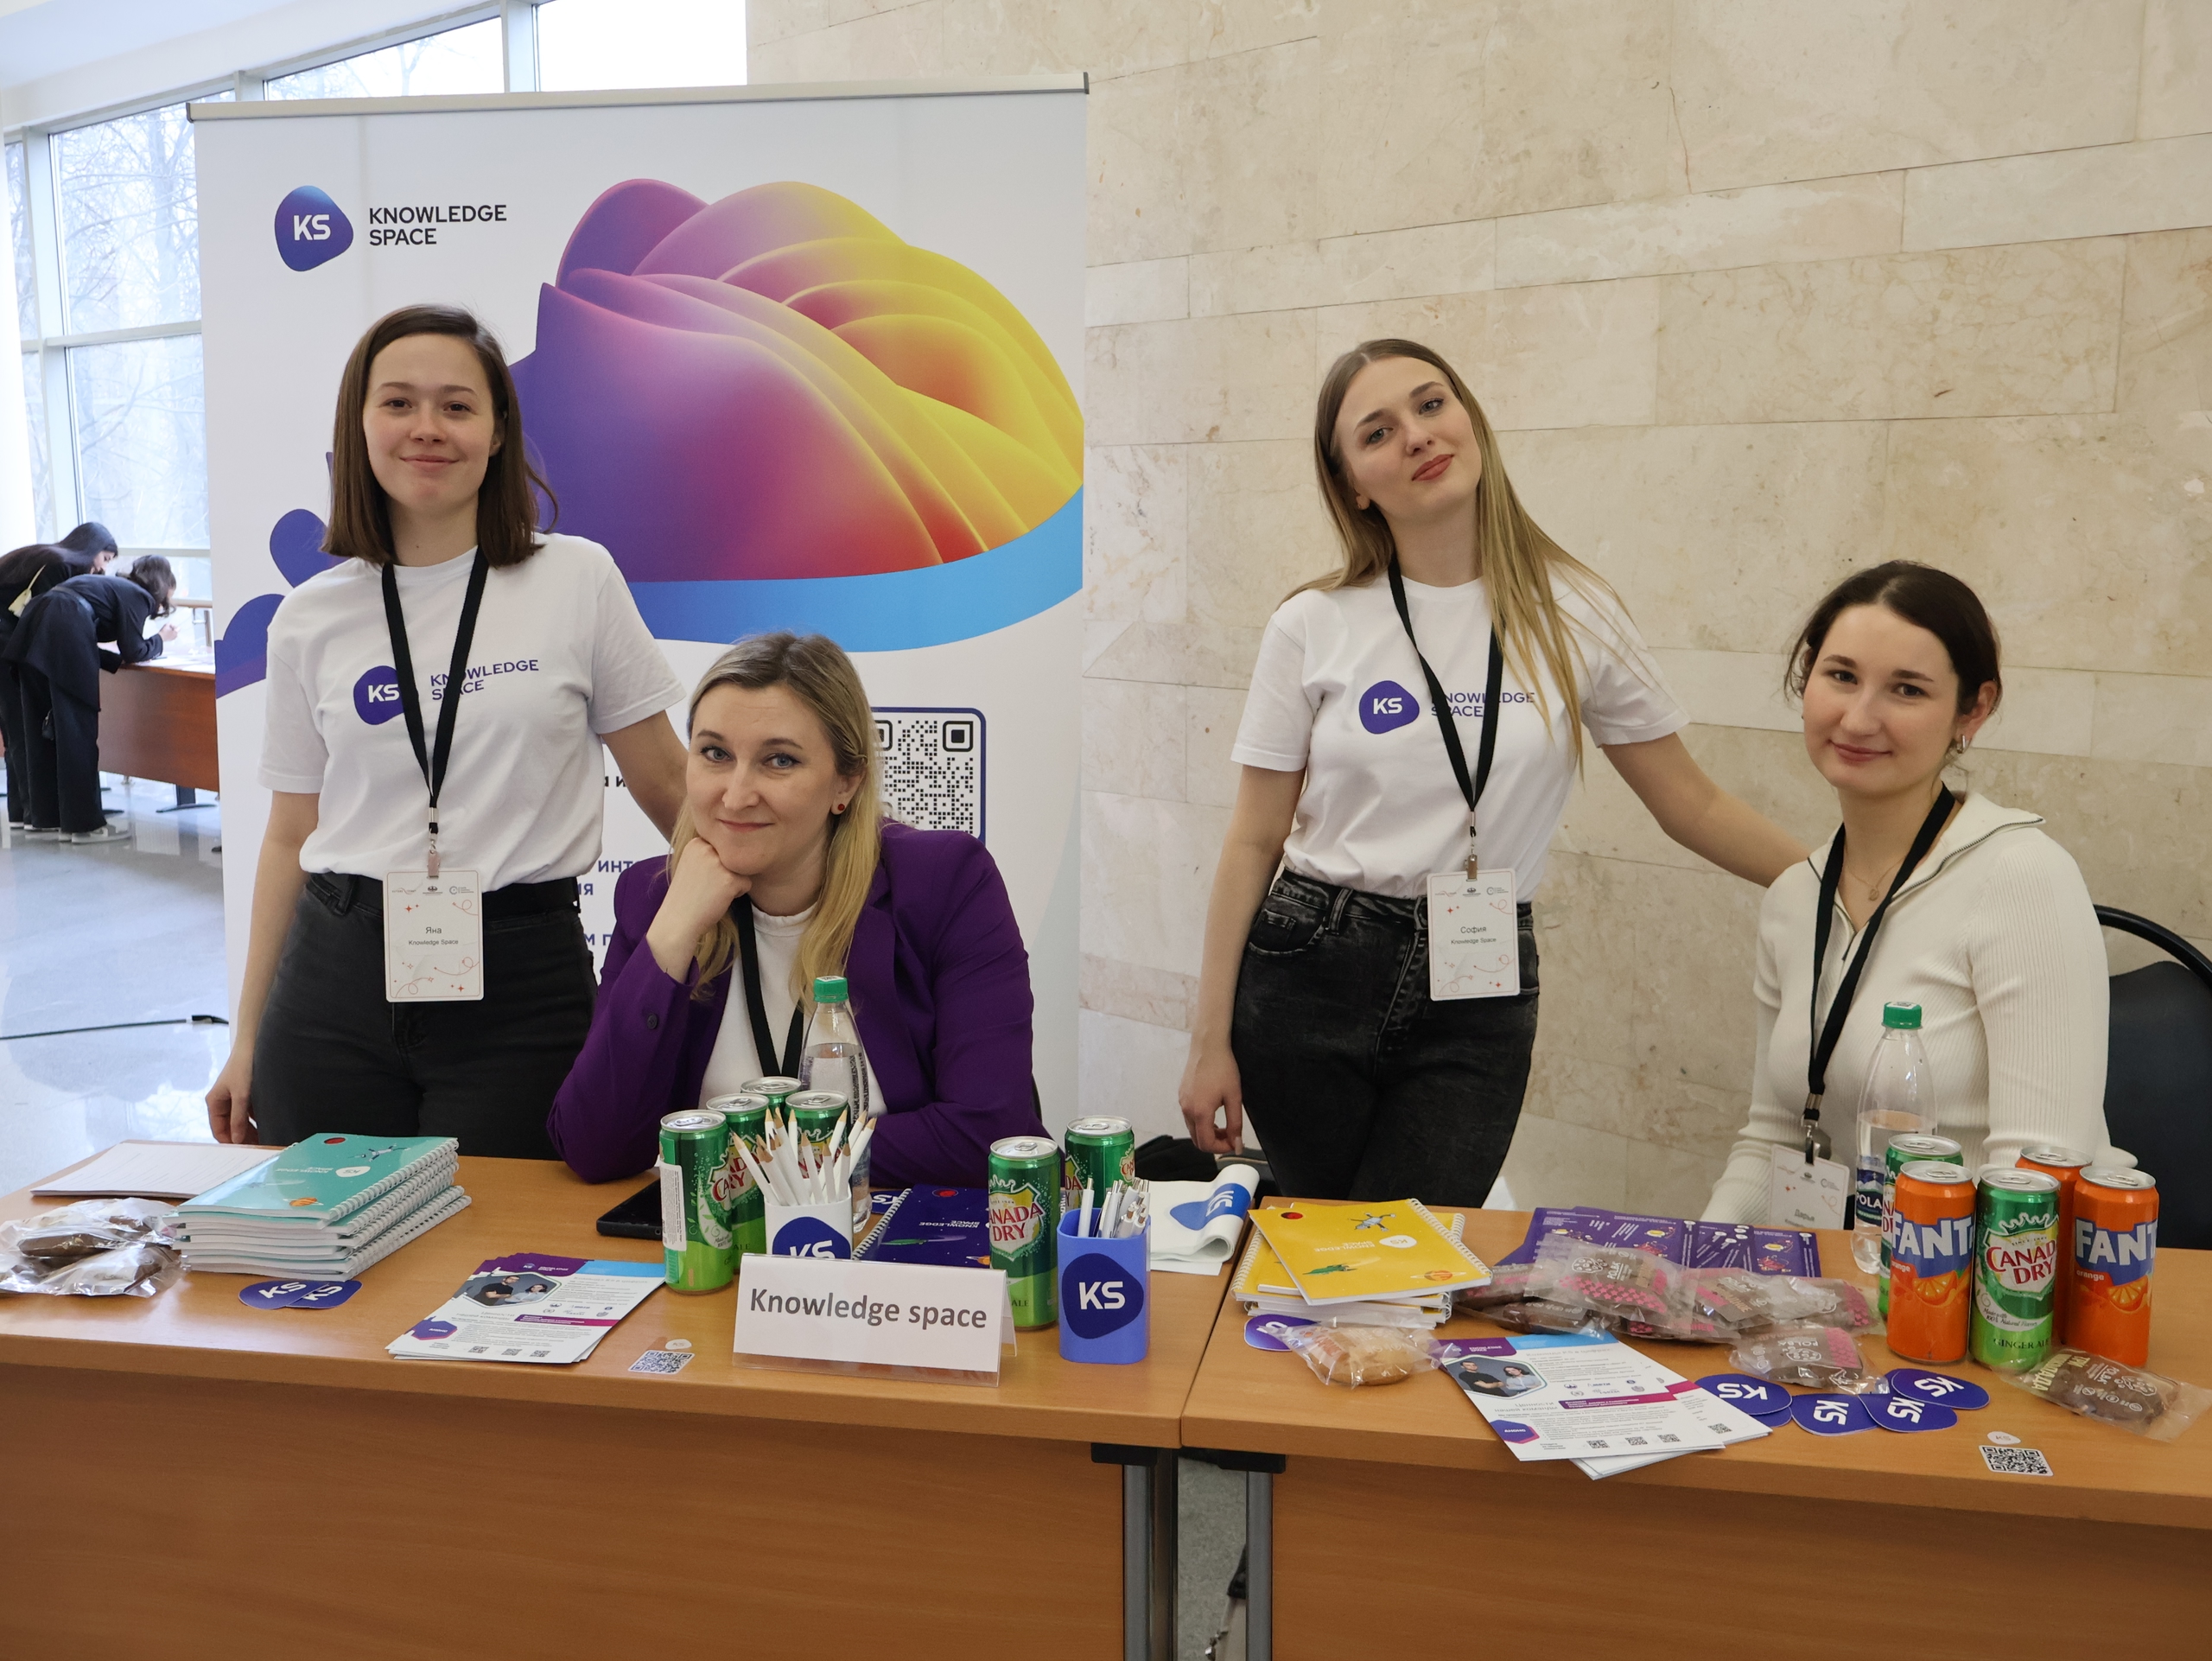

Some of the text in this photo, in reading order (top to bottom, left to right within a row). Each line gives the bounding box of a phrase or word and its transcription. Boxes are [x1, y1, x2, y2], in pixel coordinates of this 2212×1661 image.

[369, 205, 507, 225] KNOWLEDGE
[294, 214, 332, 241] KS
[369, 228, 437, 246] SPACE
[368, 684, 400, 703] KS
[432, 679, 485, 701] SCE
[1373, 697, 1403, 715] KS
[1431, 706, 1484, 717] SACE
[989, 1202, 1044, 1225] ANADA
[993, 1223, 1026, 1242] DRY
[2076, 1219, 2158, 1265] FANT
[1986, 1240, 2056, 1272] CANAD
[2013, 1258, 2053, 1285] DRY
[2077, 1270, 2105, 1282] orange
[259, 1282, 307, 1298] KS
[1078, 1281, 1126, 1310] KS
[750, 1288, 988, 1330] Knowledge space
[1993, 1339, 2034, 1349] GINGER
[1717, 1383, 1768, 1400] KS
[1914, 1377, 1964, 1397] KS
[1814, 1399, 1849, 1425] KS
[1887, 1397, 1924, 1424] KS
